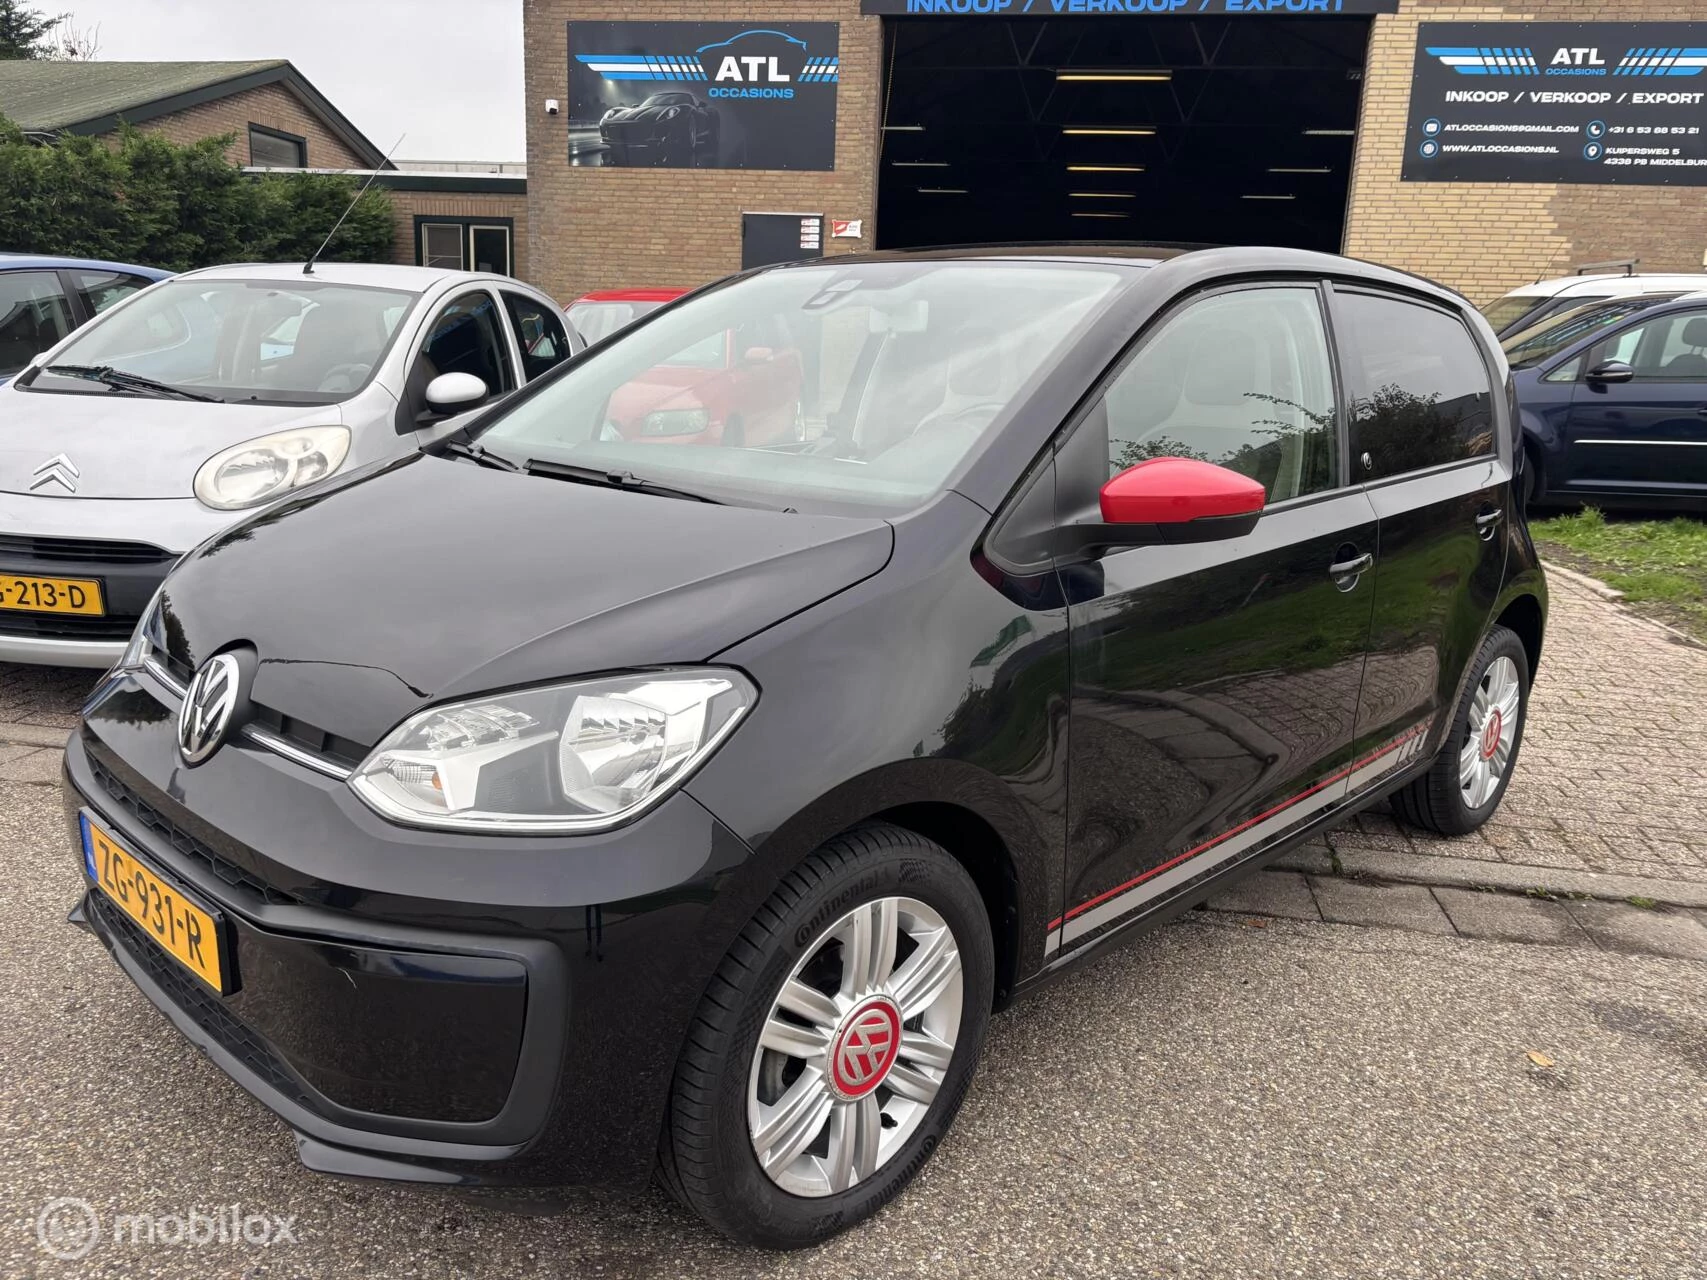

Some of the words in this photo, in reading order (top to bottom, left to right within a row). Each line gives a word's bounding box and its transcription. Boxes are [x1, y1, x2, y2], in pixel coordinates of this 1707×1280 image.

[906, 0, 1011, 12] INKOOP
[1050, 0, 1188, 11] VERKOOP
[1225, 0, 1348, 11] EXPORT
[1551, 47, 1605, 65] ATL
[715, 56, 790, 82] ATL
[1545, 68, 1607, 76] OCCASIONS
[708, 87, 794, 99] OCCASIONS
[1445, 90, 1510, 103] INKOOP
[1529, 91, 1612, 104] VERKOOP
[1631, 92, 1704, 104] EXPORT
[1442, 145, 1560, 154] WWW.ATLOCCASIONS.NL
[98, 838, 206, 970] ZG-931-R
